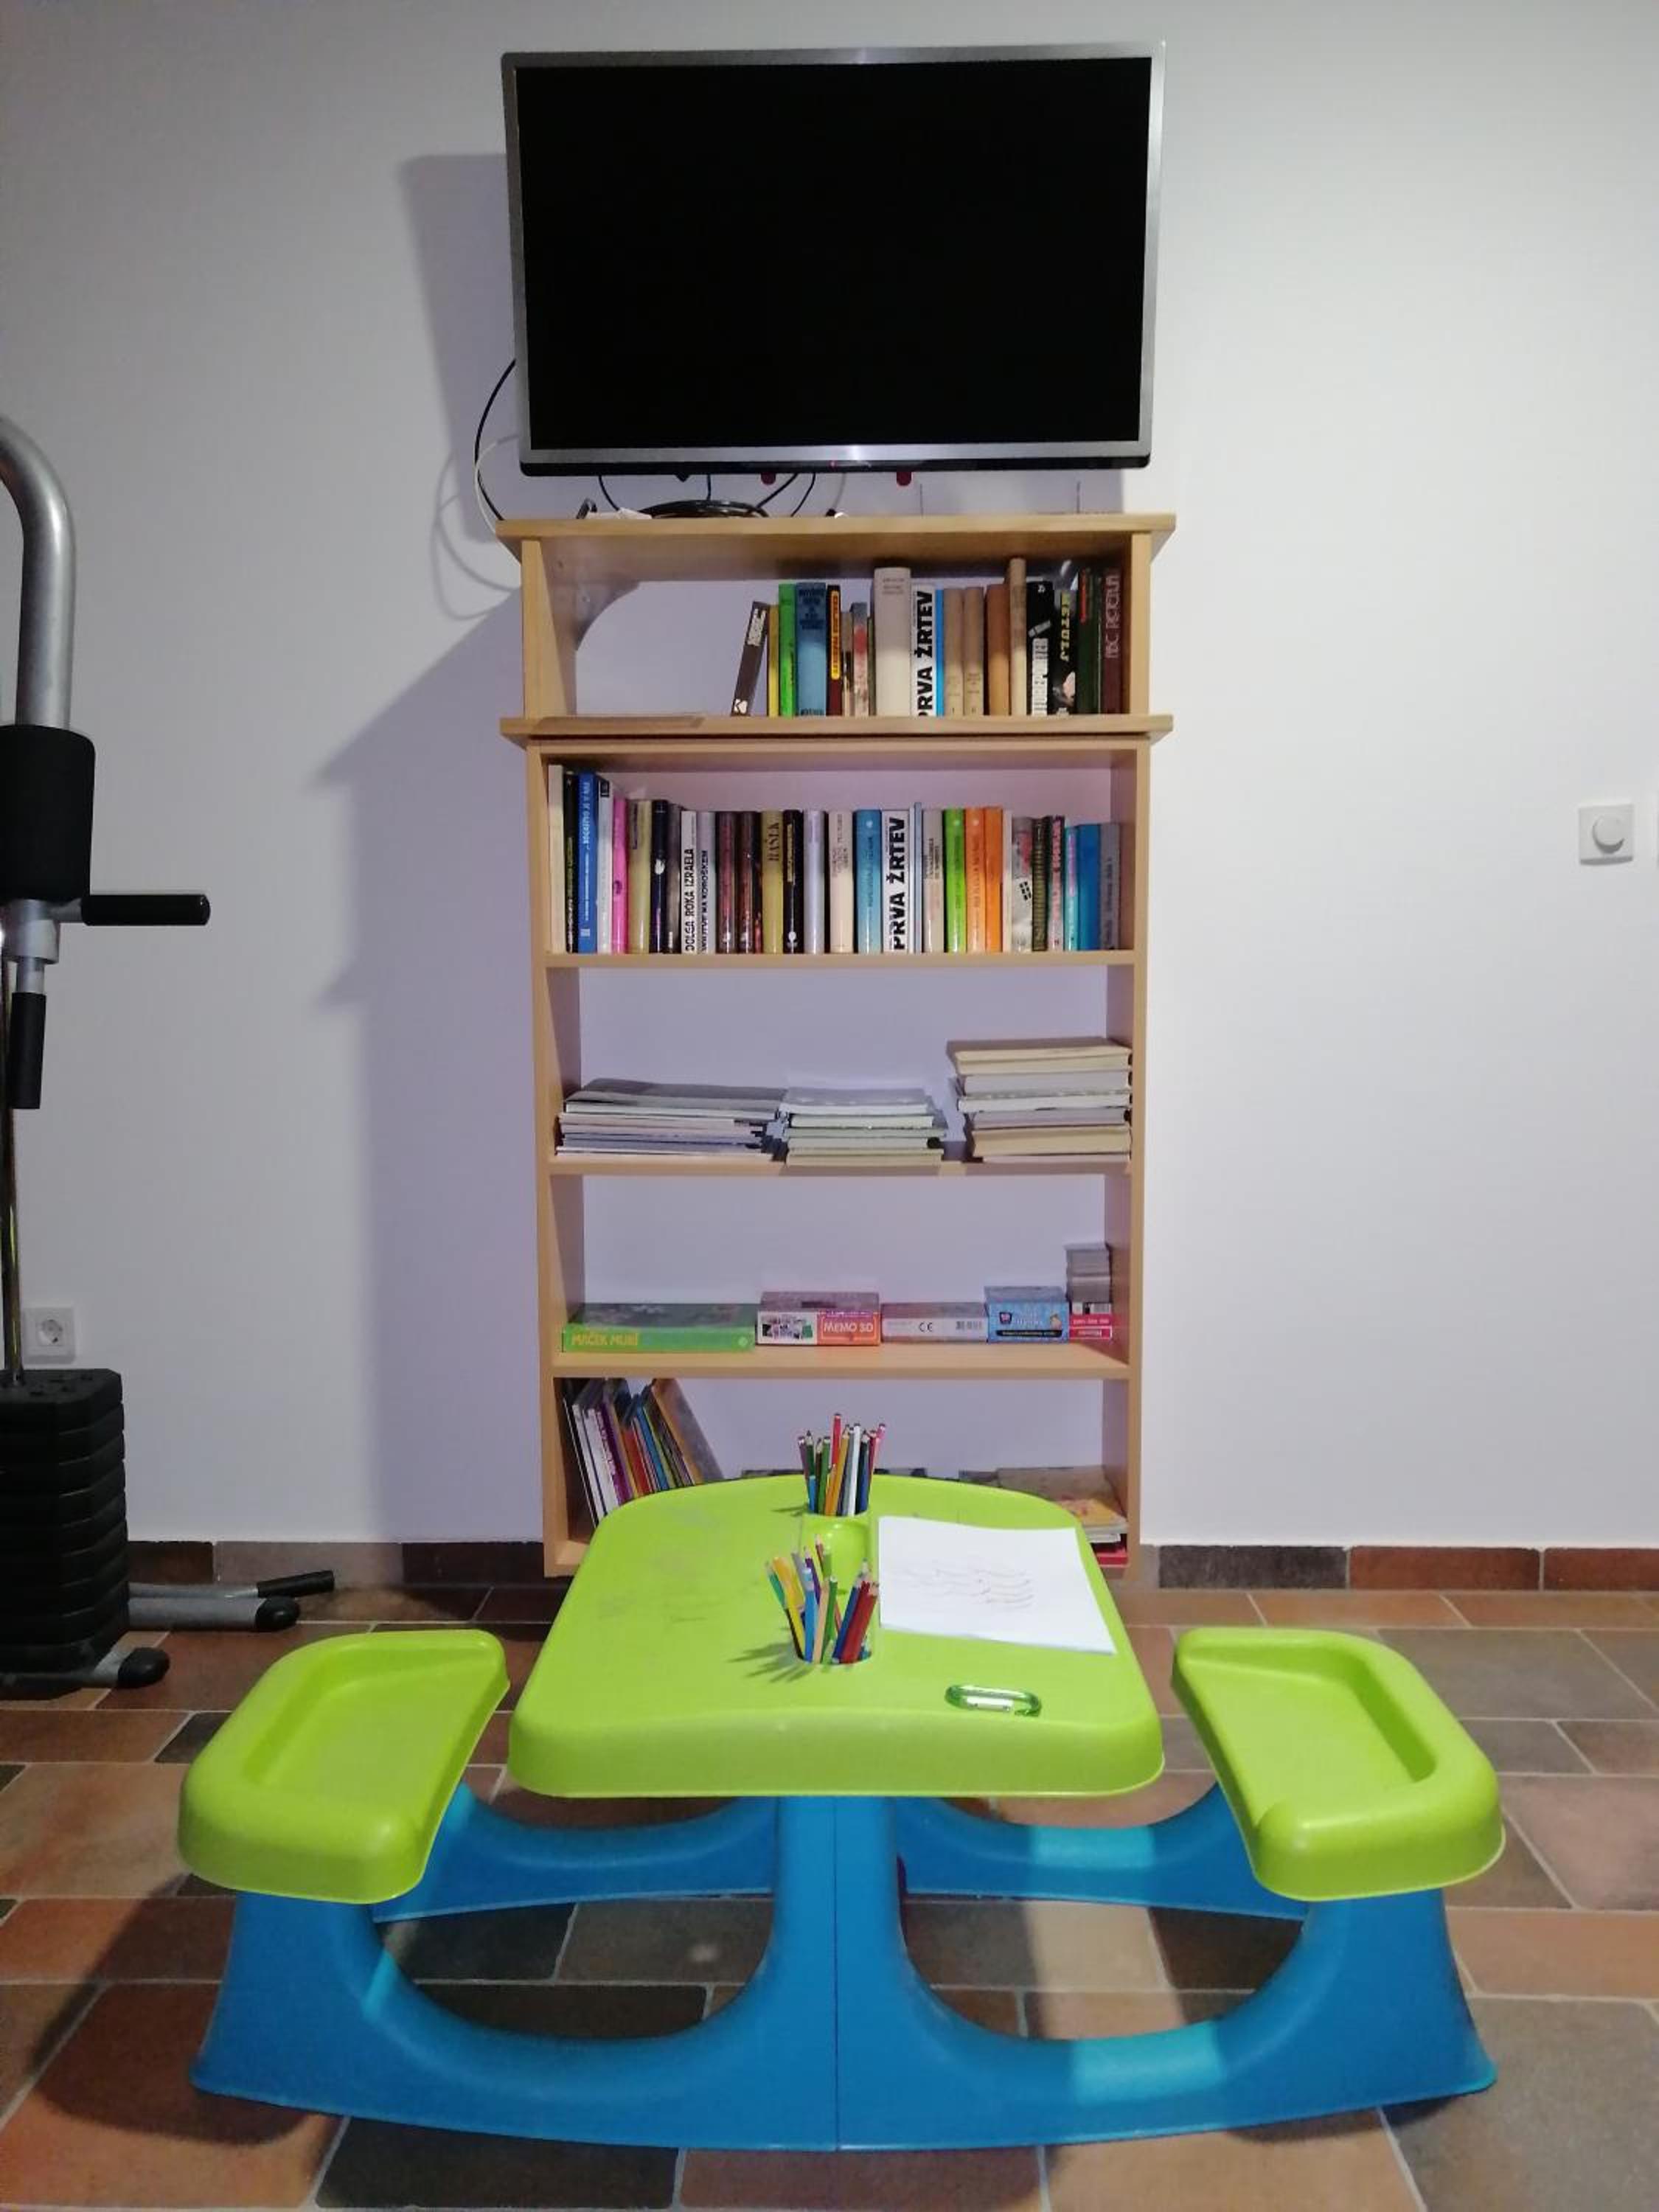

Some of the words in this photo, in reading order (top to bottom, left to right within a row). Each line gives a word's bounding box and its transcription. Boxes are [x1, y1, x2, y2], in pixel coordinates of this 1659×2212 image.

[914, 591, 933, 658] ŽRTEV
[765, 822, 779, 862] HAŠEK
[886, 817, 905, 884] ŽRTEV
[684, 849, 694, 888] IZRAELA
[684, 891, 695, 917] ROKA
[889, 891, 905, 950] PRVA
[684, 922, 695, 952] DOLGA
[824, 1322, 858, 1332] MEMO
[859, 1322, 874, 1332] 3D
